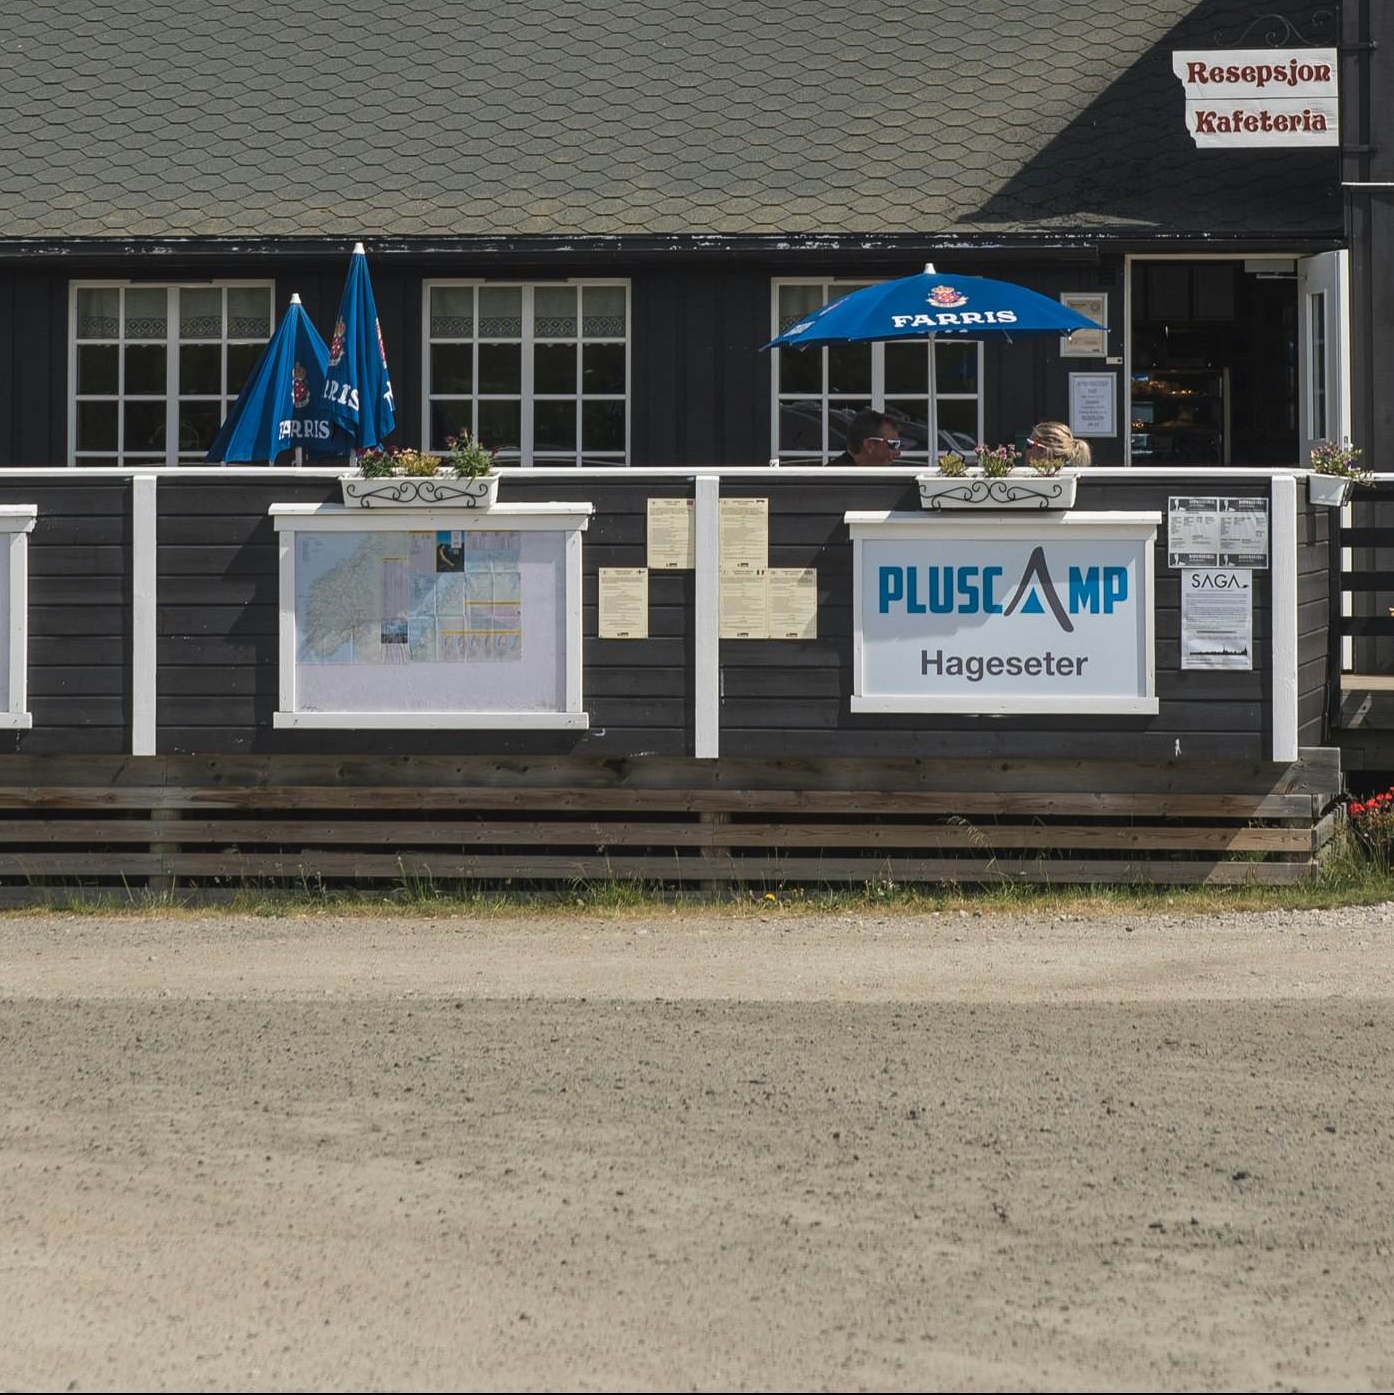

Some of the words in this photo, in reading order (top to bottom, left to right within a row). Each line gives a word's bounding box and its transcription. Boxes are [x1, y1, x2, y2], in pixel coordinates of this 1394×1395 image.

[1187, 59, 1331, 87] Resepsjon
[1195, 109, 1327, 133] Kafeteria
[891, 310, 1018, 328] FARRIS
[879, 546, 1129, 633] PLUSCAMP
[1191, 573, 1240, 589] SAGA
[921, 650, 1089, 682] Hageseter
